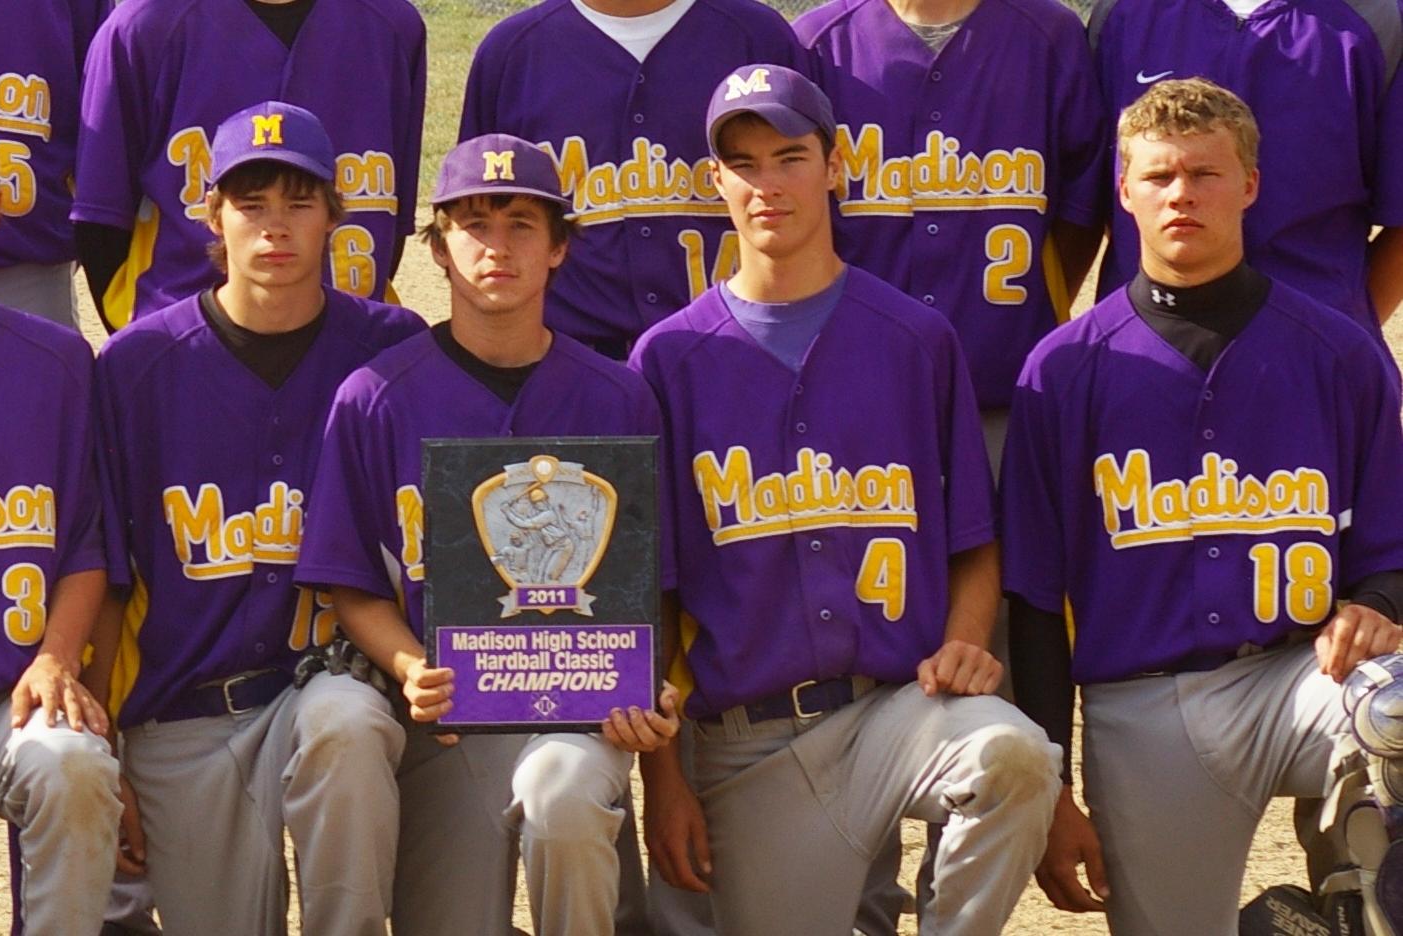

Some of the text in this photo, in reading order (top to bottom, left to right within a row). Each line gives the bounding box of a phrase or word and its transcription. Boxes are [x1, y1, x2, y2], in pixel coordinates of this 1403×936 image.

[725, 68, 772, 101] M
[252, 113, 284, 146] M
[482, 150, 516, 181] M
[836, 123, 1046, 200] Madison
[536, 136, 720, 211] Madiso
[330, 224, 377, 298] 6
[983, 224, 1032, 305] 2
[163, 481, 305, 564] Madi
[693, 445, 915, 531] Madison
[1094, 448, 1330, 535] Madison
[2, 562, 46, 646] 3
[527, 590, 566, 604] 2011
[856, 538, 906, 622] 4
[1249, 542, 1332, 625] 18
[452, 630, 636, 652] Madison High School
[475, 650, 614, 671] Hardball Classic
[477, 671, 619, 692] CHAMPIONS
